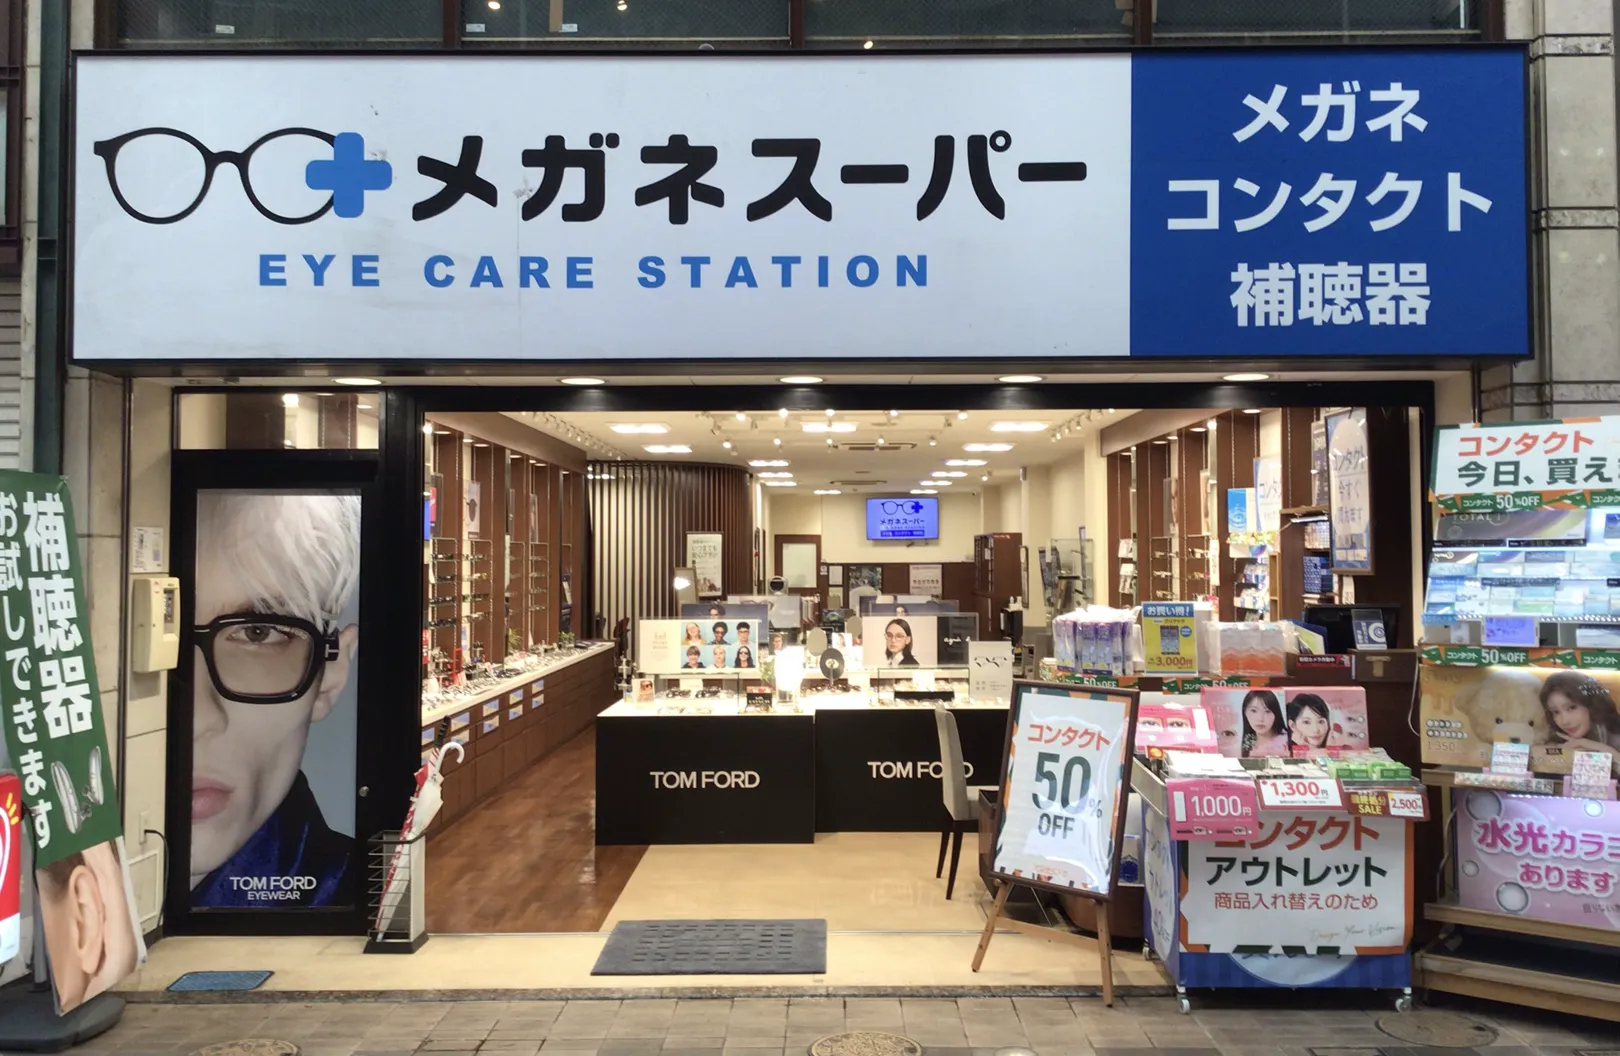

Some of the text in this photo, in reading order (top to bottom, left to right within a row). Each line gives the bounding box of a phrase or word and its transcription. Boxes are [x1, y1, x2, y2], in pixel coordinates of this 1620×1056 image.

[1232, 80, 1428, 143] メガネ
[412, 130, 1087, 224] メガネスーパー
[1168, 171, 1493, 233] コンタクト
[259, 254, 928, 288] EYE CARE STATION
[1230, 262, 1431, 327] 補聴器
[1459, 430, 1594, 457] コンタクト
[1458, 456, 1620, 488] 今日、買え
[1463, 499, 1494, 507] コンタクト
[23, 491, 93, 740] 補聴器
[1447, 651, 1478, 660] コンタクト
[0, 490, 53, 849] お試しできます
[1027, 724, 1110, 751] コンタクト
[650, 771, 760, 788] TOM FORD
[867, 761, 974, 779] TOM FOD
[1271, 781, 1329, 797] 1,300円
[1191, 795, 1252, 817] 1,000円
[1358, 805, 1382, 815] SALE
[1038, 812, 1075, 840] OFF
[229, 876, 317, 890] TOM FORD
[1206, 857, 1387, 887] アウトレット
[1520, 863, 1614, 893] あります
[248, 891, 300, 900] EYEWEAR
[1214, 892, 1378, 910] 商品入れ替えのため
